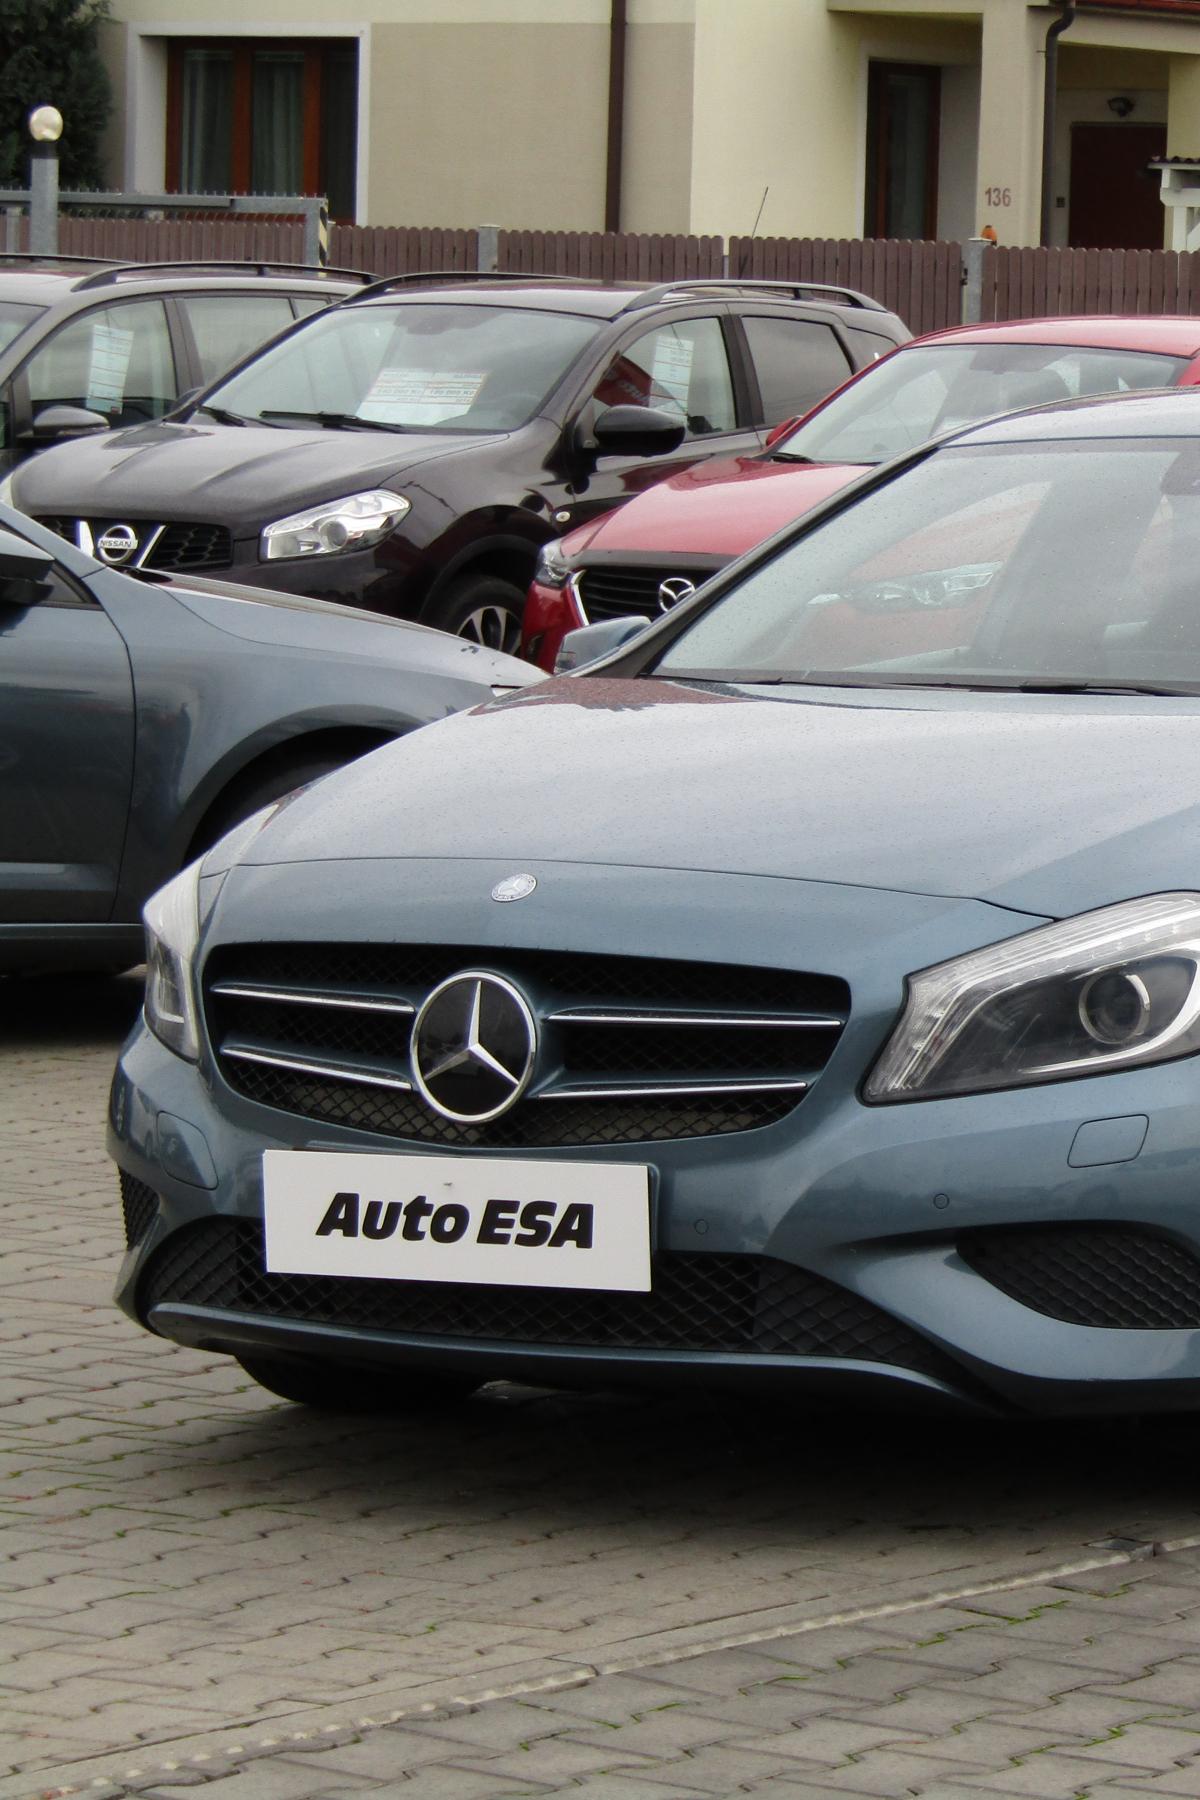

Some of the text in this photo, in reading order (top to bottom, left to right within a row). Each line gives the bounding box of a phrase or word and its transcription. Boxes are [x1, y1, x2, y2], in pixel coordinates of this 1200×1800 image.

[984, 187, 1011, 207] 136
[101, 540, 131, 548] NISSAN
[315, 1192, 594, 1249] Auto ESA
